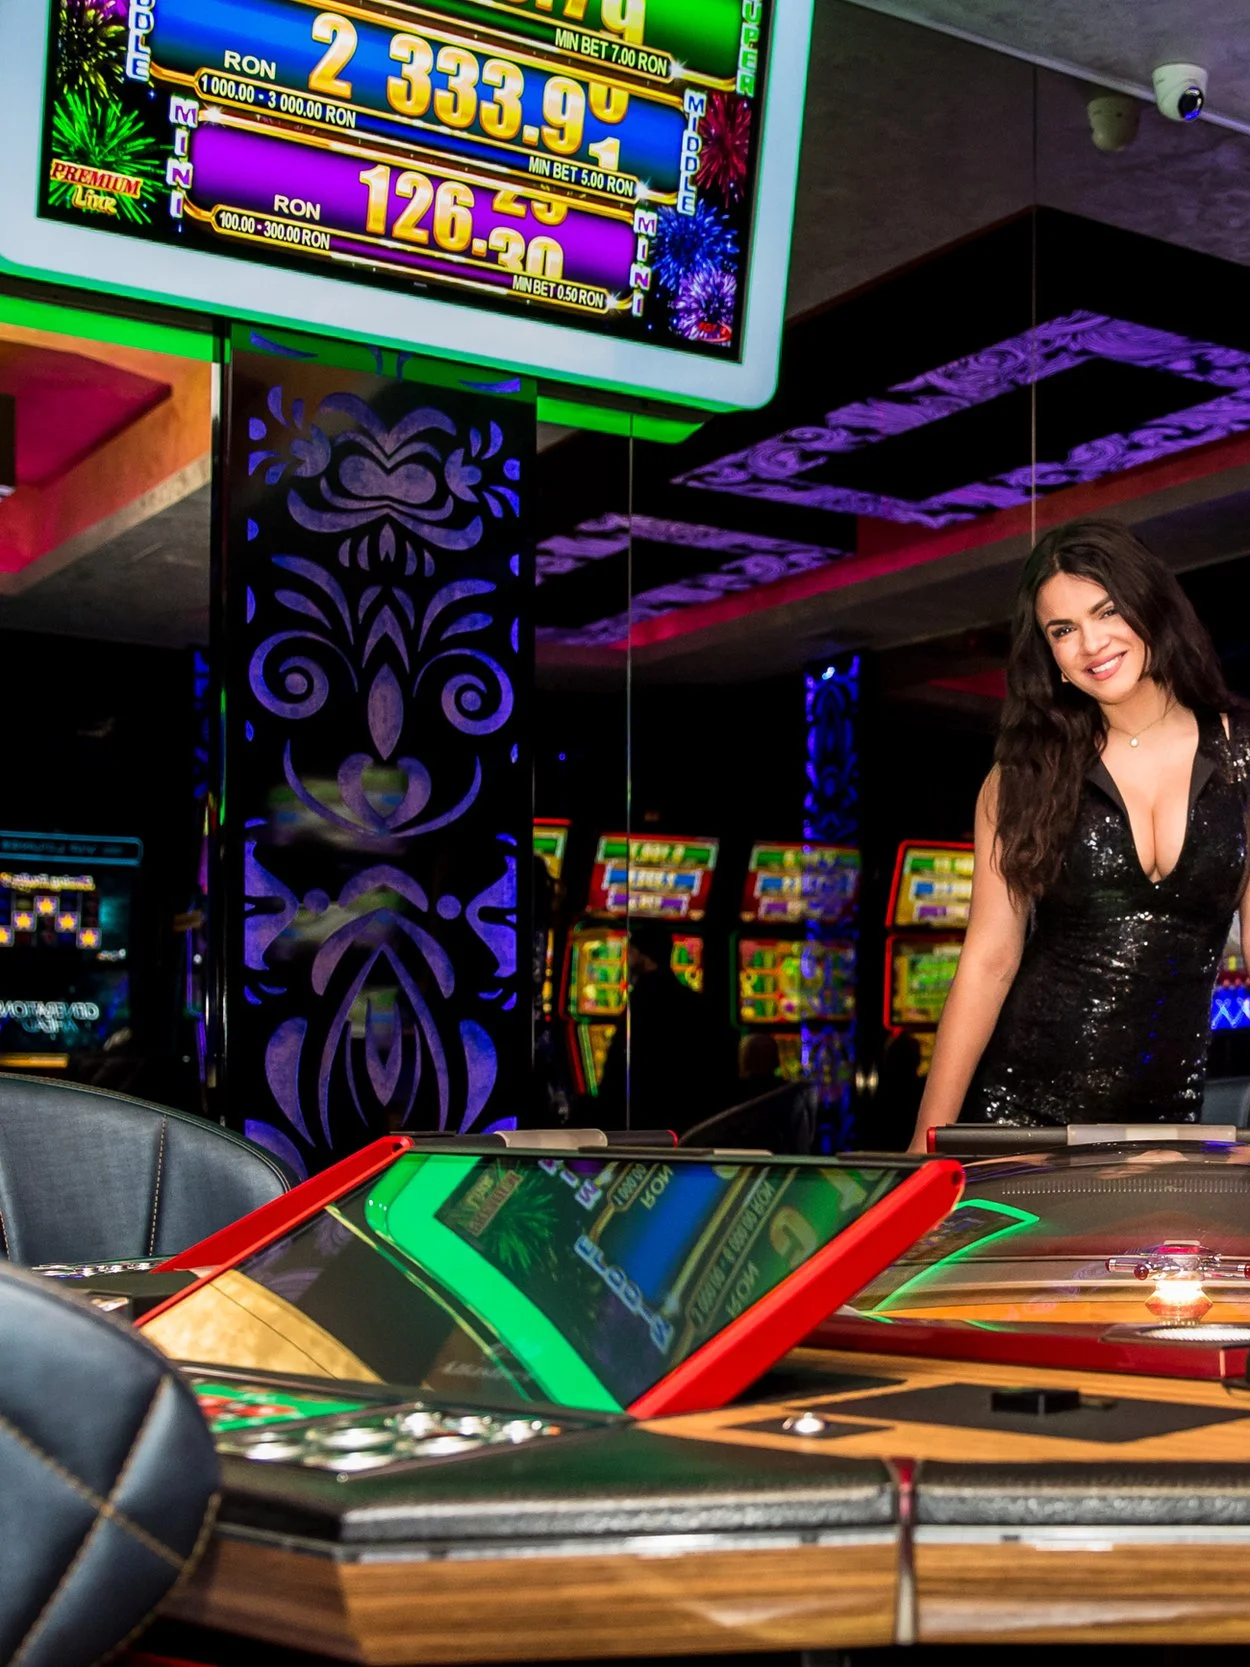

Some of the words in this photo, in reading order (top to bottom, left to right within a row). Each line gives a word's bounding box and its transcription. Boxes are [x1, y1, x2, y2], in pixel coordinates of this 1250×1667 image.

[223, 50, 276, 80] RON
[308, 12, 358, 99] 2
[555, 28, 579, 52] MIN
[581, 35, 609, 60] BET
[611, 43, 636, 68] 7.00
[638, 51, 668, 77] RON
[280, 95, 322, 120] 000.00
[325, 108, 357, 129] RON
[166, 95, 200, 218] MINI
[676, 88, 708, 216] MIDDLE
[50, 159, 143, 198] PREMIUM
[529, 156, 551, 178] MIN
[553, 162, 577, 184] BET
[580, 169, 604, 189] 5.00
[606, 175, 635, 198] RON
[274, 194, 321, 221] RON
[219, 211, 255, 234] 100.00
[264, 221, 300, 243] 300.00
[302, 229, 330, 250] RON
[629, 208, 658, 317] MINI
[512, 275, 532, 293] MIN
[533, 279, 556, 298] BET
[557, 285, 578, 303] 0.50
[579, 289, 604, 308] RON
